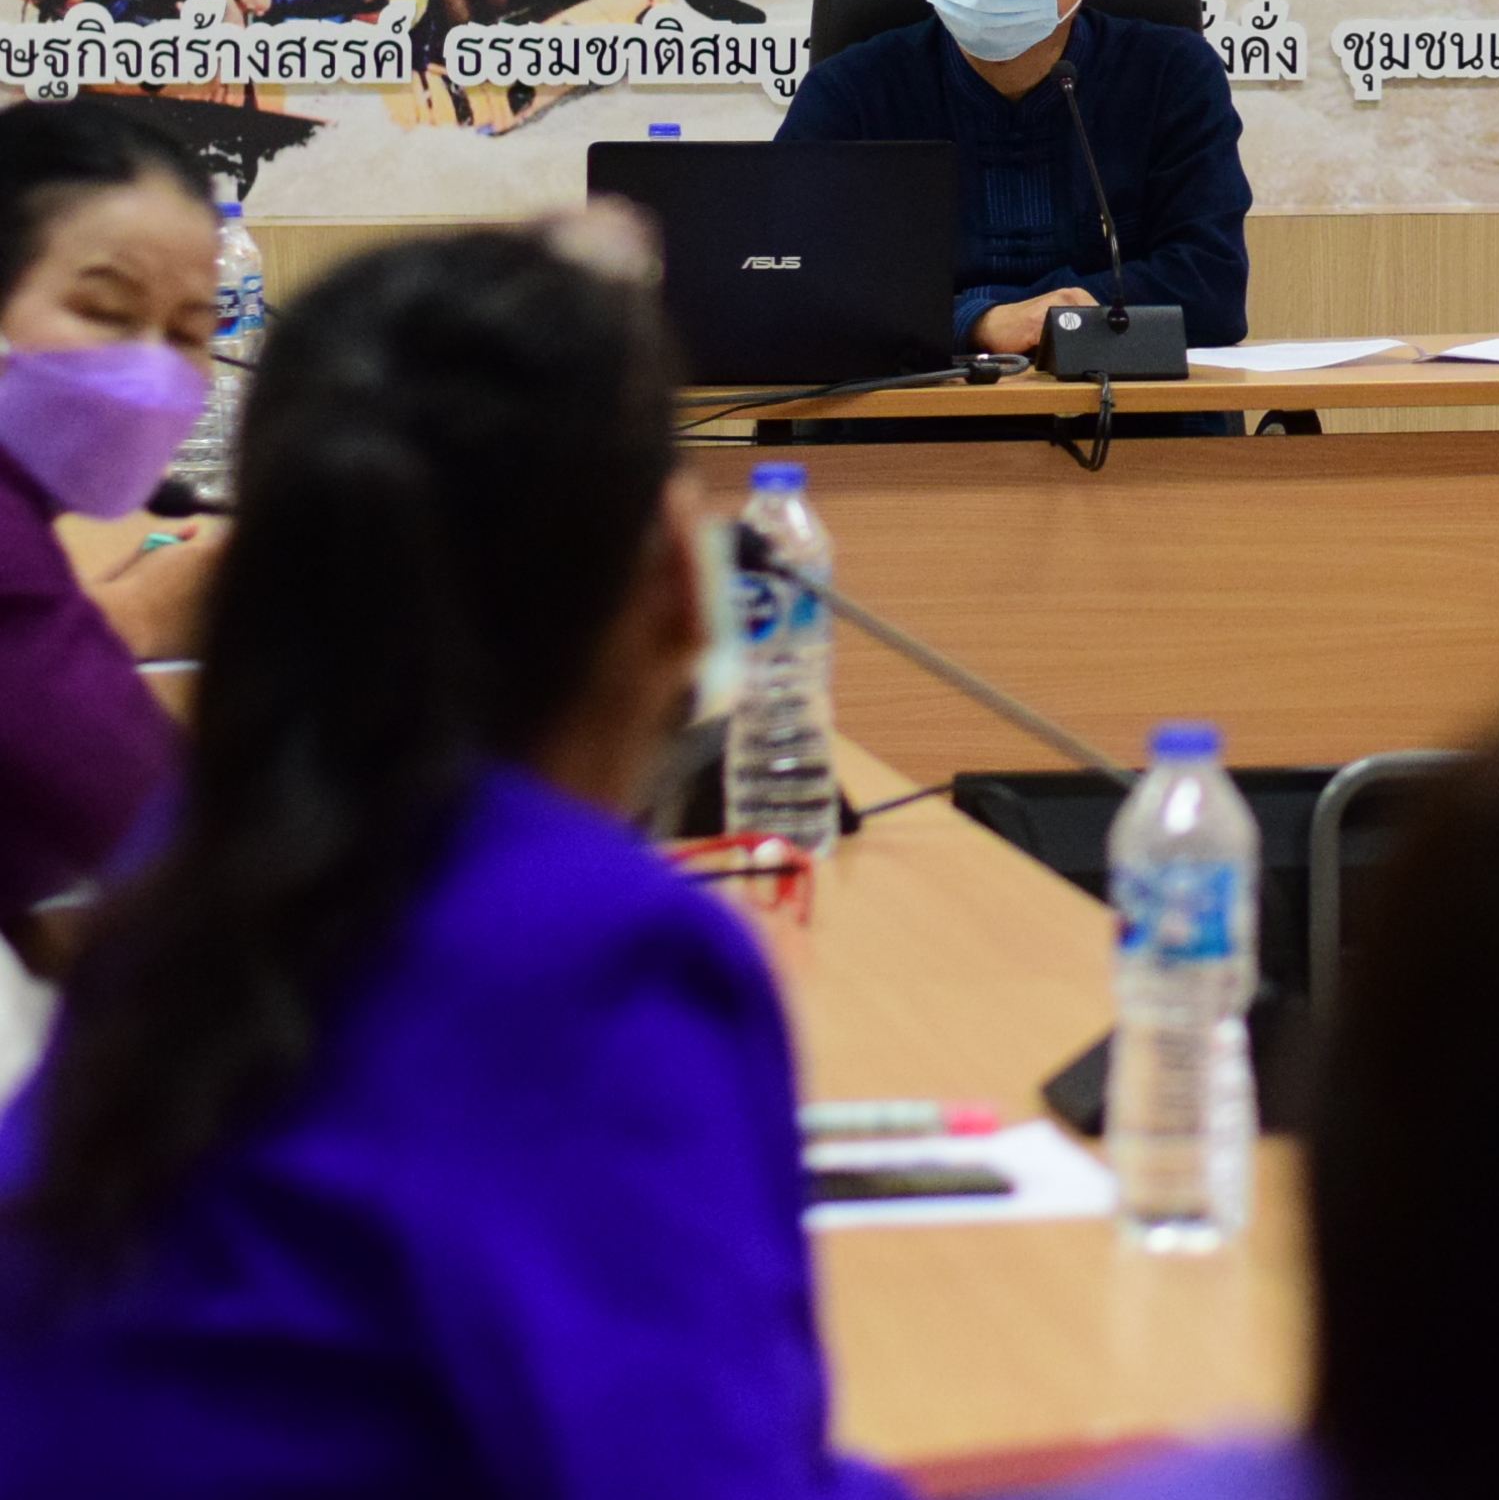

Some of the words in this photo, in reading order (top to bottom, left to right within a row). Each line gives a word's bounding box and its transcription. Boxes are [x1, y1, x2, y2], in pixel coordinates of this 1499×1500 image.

[455, 17, 811, 98] ธรรมชาติสมบู
[741, 256, 801, 270] ASUS
